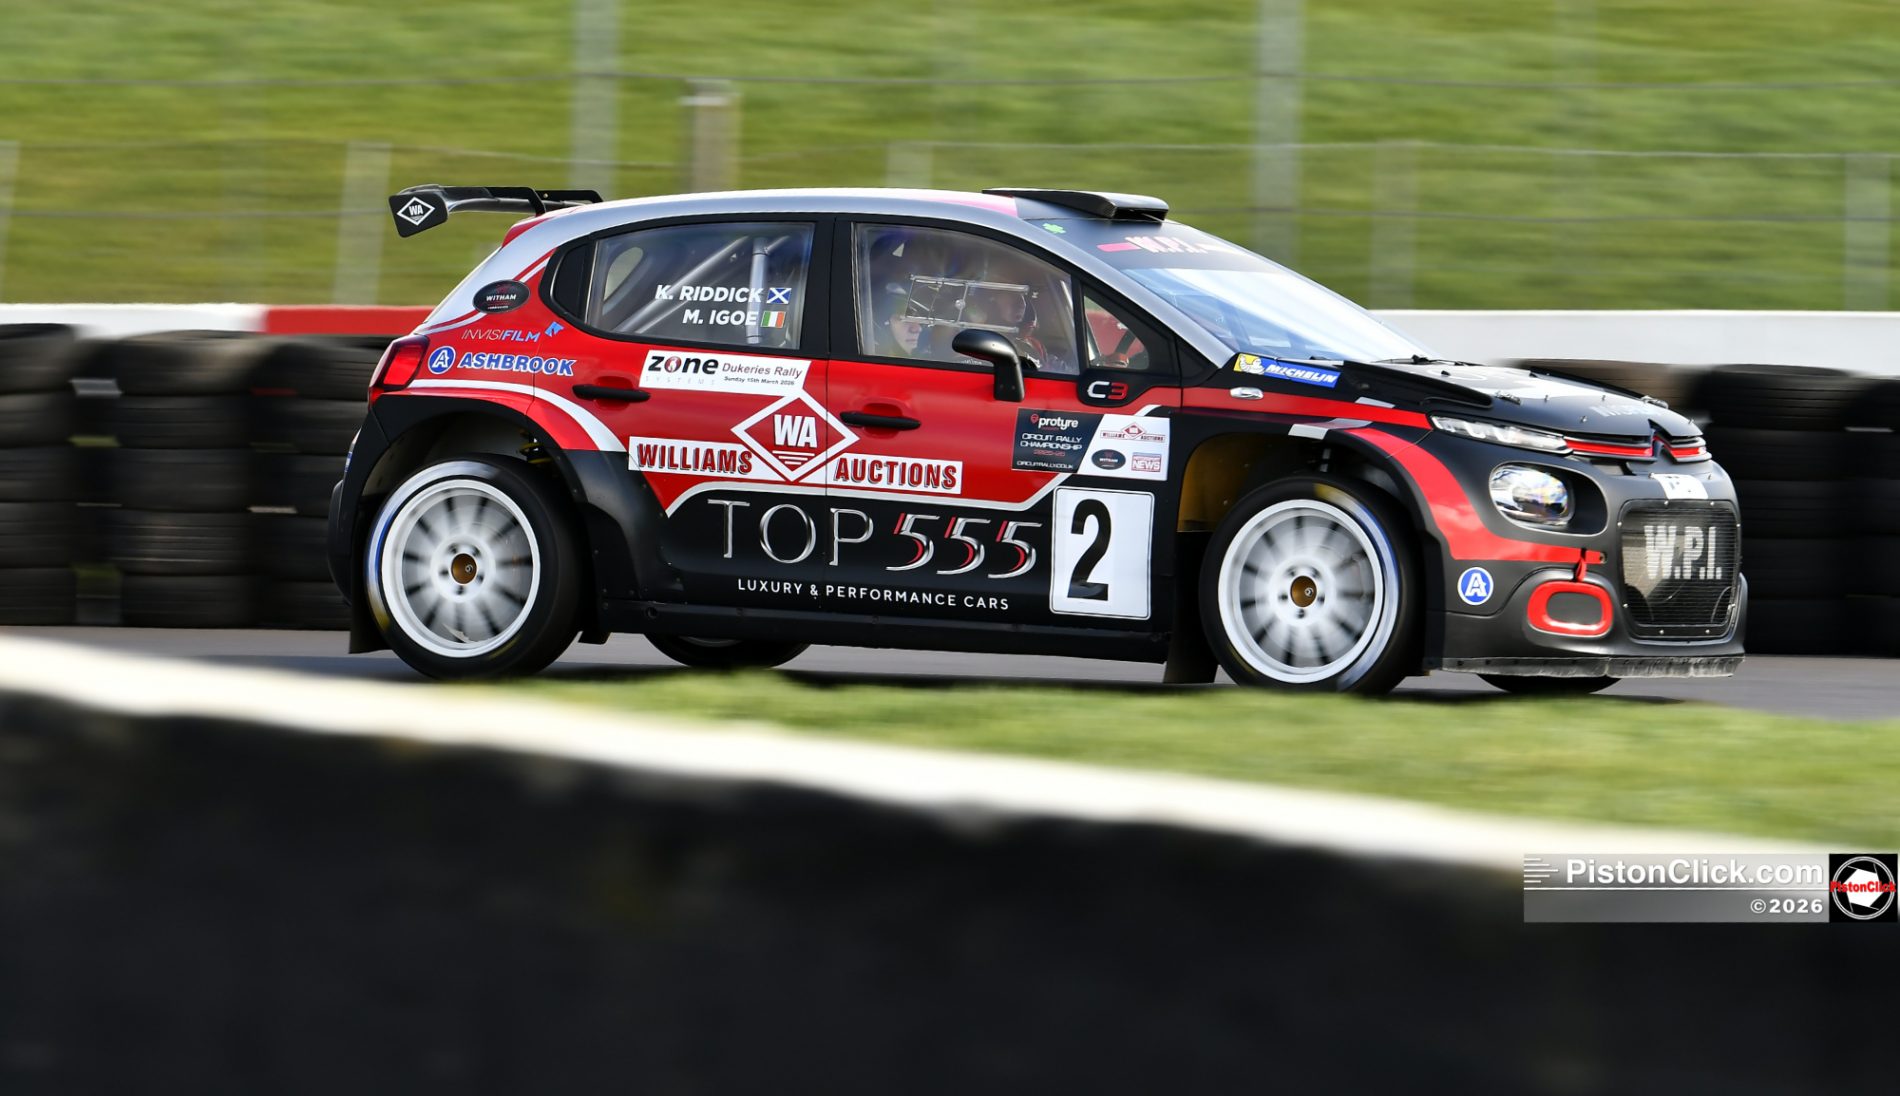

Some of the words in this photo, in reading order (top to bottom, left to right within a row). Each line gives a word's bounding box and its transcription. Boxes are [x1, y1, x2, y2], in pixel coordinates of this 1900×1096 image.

[408, 204, 424, 216] WA
[486, 294, 517, 302] WITHAM
[655, 285, 673, 300] K.
[679, 286, 764, 303] RIDDICK
[682, 309, 703, 325] M.
[709, 310, 759, 326] IGOE
[461, 329, 541, 342] INVISIFILM
[457, 352, 577, 376] ASHBROOK
[648, 355, 719, 375] zone
[722, 362, 770, 376] Dukeries
[774, 366, 802, 380] Rally
[724, 376, 745, 384] Sunday
[761, 377, 779, 385] March
[1265, 364, 1337, 383] MICHELIN
[1087, 380, 1129, 400] C3
[773, 413, 818, 448] WA
[1038, 417, 1078, 430] protyre
[1020, 441, 1082, 450] CHAMPIONSHIP
[1022, 433, 1054, 441] CIRCUIT
[637, 444, 752, 474] WILLIAMS
[1133, 459, 1160, 471] NEWS
[834, 457, 957, 489] AUCTIONS
[708, 499, 874, 567] TOP
[885, 512, 1042, 579] 555
[1067, 498, 1112, 602] 2
[1644, 525, 1722, 580] W.P.I.
[738, 579, 802, 596] LUXURY
[809, 584, 820, 597] &
[826, 585, 956, 607] PERFORMANCE
[964, 596, 1009, 611] CARS
